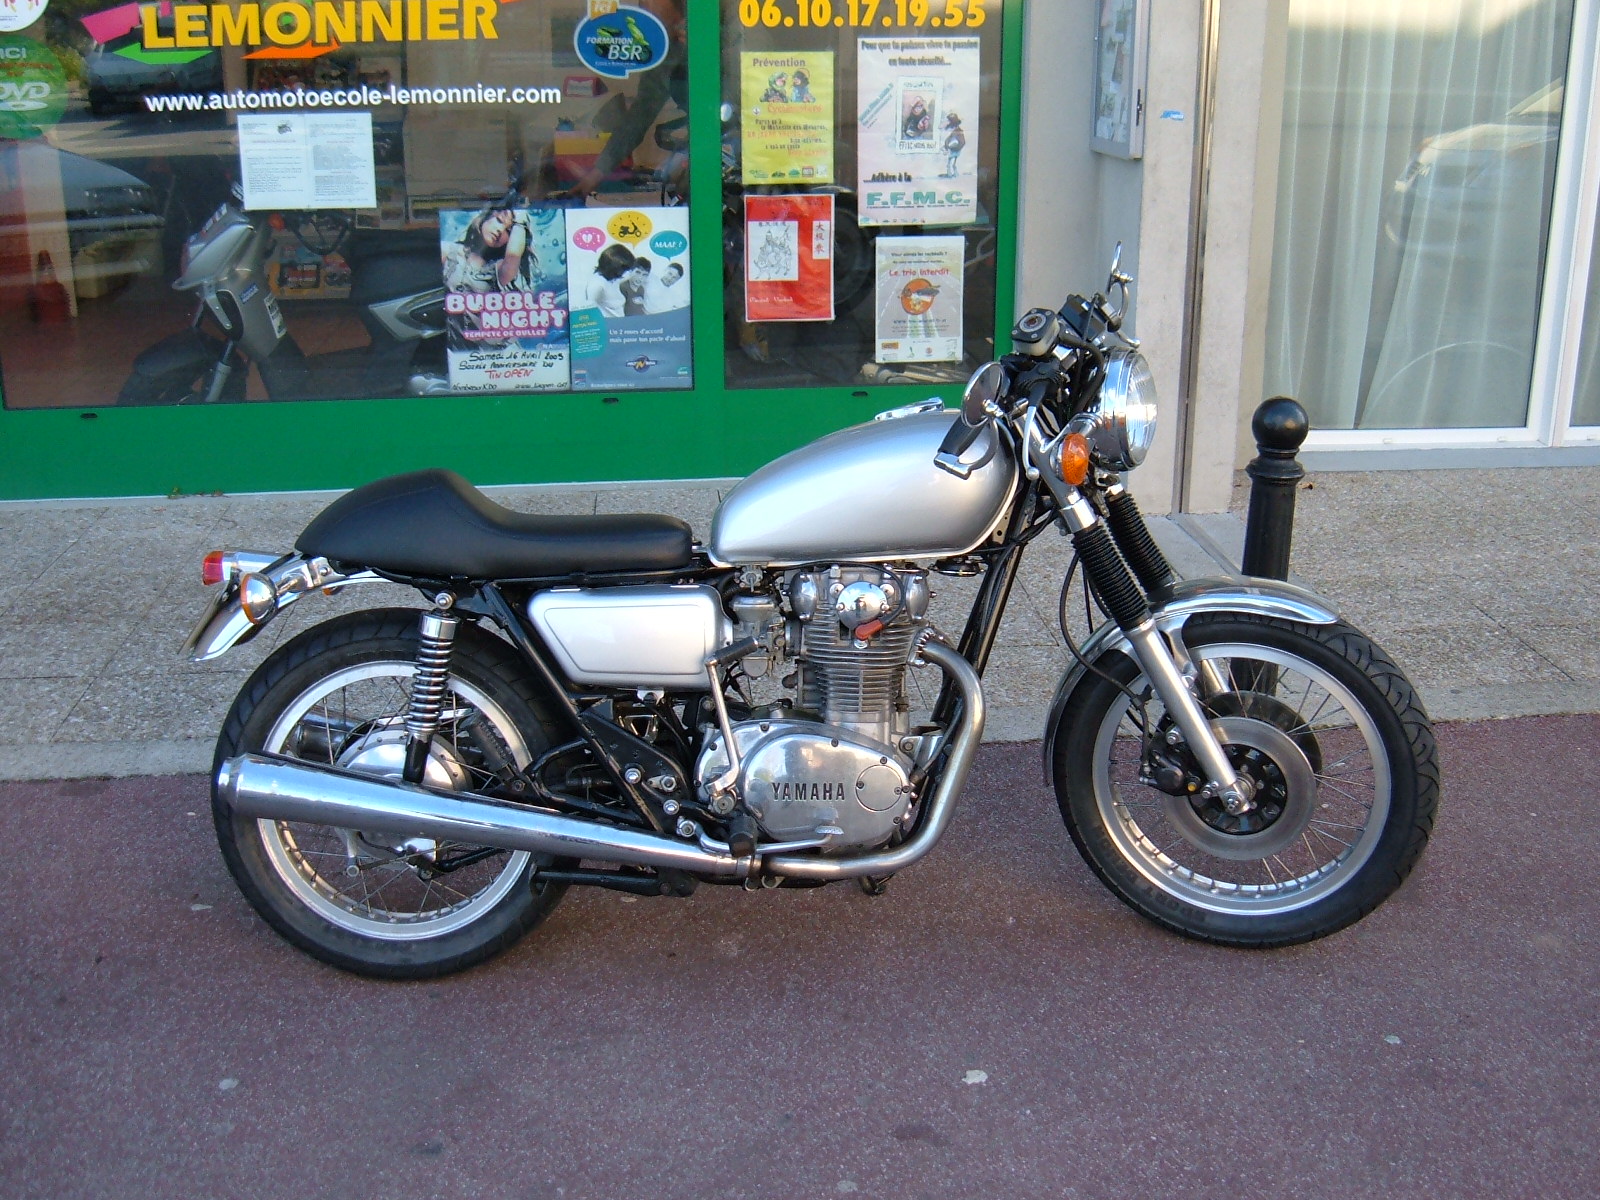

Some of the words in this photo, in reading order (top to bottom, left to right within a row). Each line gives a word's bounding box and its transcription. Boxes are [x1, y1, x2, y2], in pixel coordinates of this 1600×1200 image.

[738, 0, 986, 28] 06.10.17.19.55
[142, 0, 499, 49] LEMONNIER
[586, 36, 634, 45] FORMATION
[608, 44, 643, 61] BSR
[752, 57, 806, 68] Prévention
[145, 84, 562, 113] www.automotoecole-lemonnier.com
[866, 191, 971, 206] F.F.M.C.
[889, 269, 899, 277] Le
[902, 268, 917, 277] trio
[919, 267, 950, 277] interdit
[446, 291, 556, 313] BUBBLE
[481, 309, 567, 329] NIGHT
[503, 369, 534, 379] OPEN
[772, 782, 845, 801] YAMAHA
